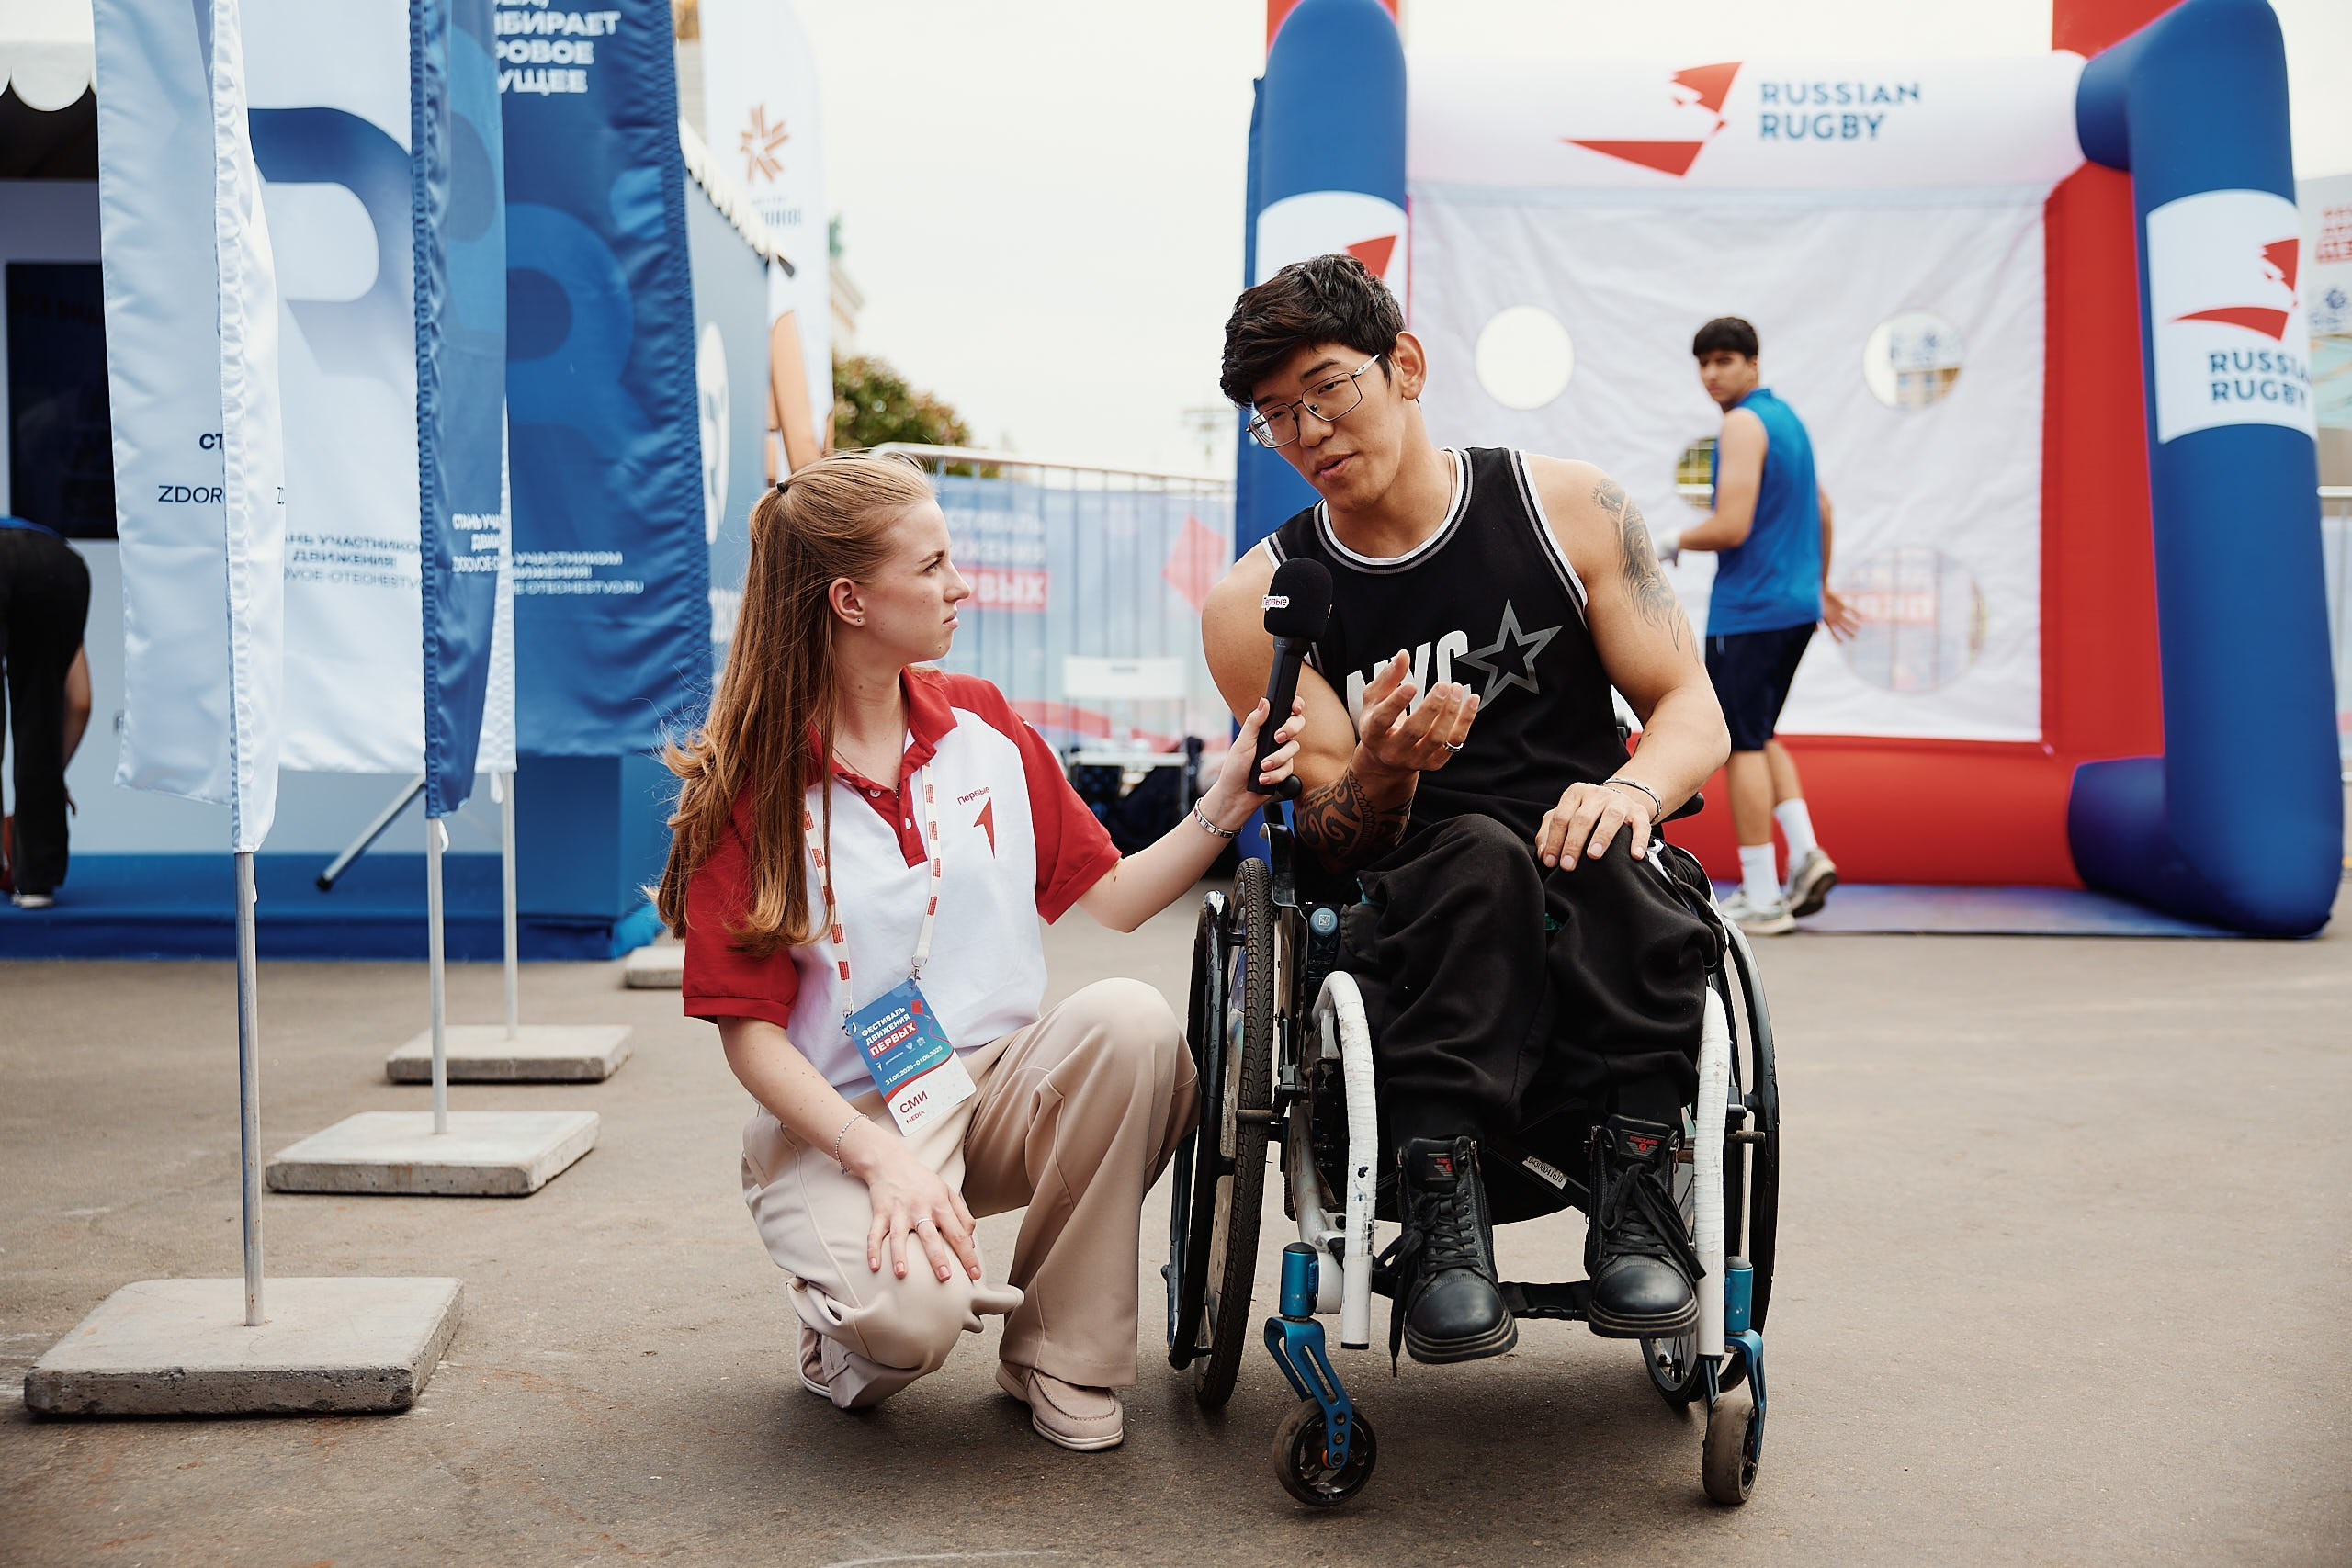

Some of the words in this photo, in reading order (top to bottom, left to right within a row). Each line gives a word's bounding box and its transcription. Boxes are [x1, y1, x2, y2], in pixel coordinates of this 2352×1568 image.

[496, 39, 594, 64] РОВОЕ
[497, 68, 588, 96] УЩЕЕ
[1760, 84, 1919, 105] RUSSIAN
[1760, 114, 1884, 140] RUGBY
[199, 434, 223, 450] СТ
[158, 485, 223, 503] ZDOR
[319, 534, 420, 552] УЧАСТНИКО
[957, 786, 989, 806] Первые
[861, 1007, 906, 1037] ФЕСТИВАЛЬ
[865, 1014, 910, 1046] ДВИЖЕНИЯ
[870, 1022, 916, 1056] ПЕРВЫХ
[899, 1091, 928, 1113] СМИ
[906, 1110, 925, 1124] MEDIA
